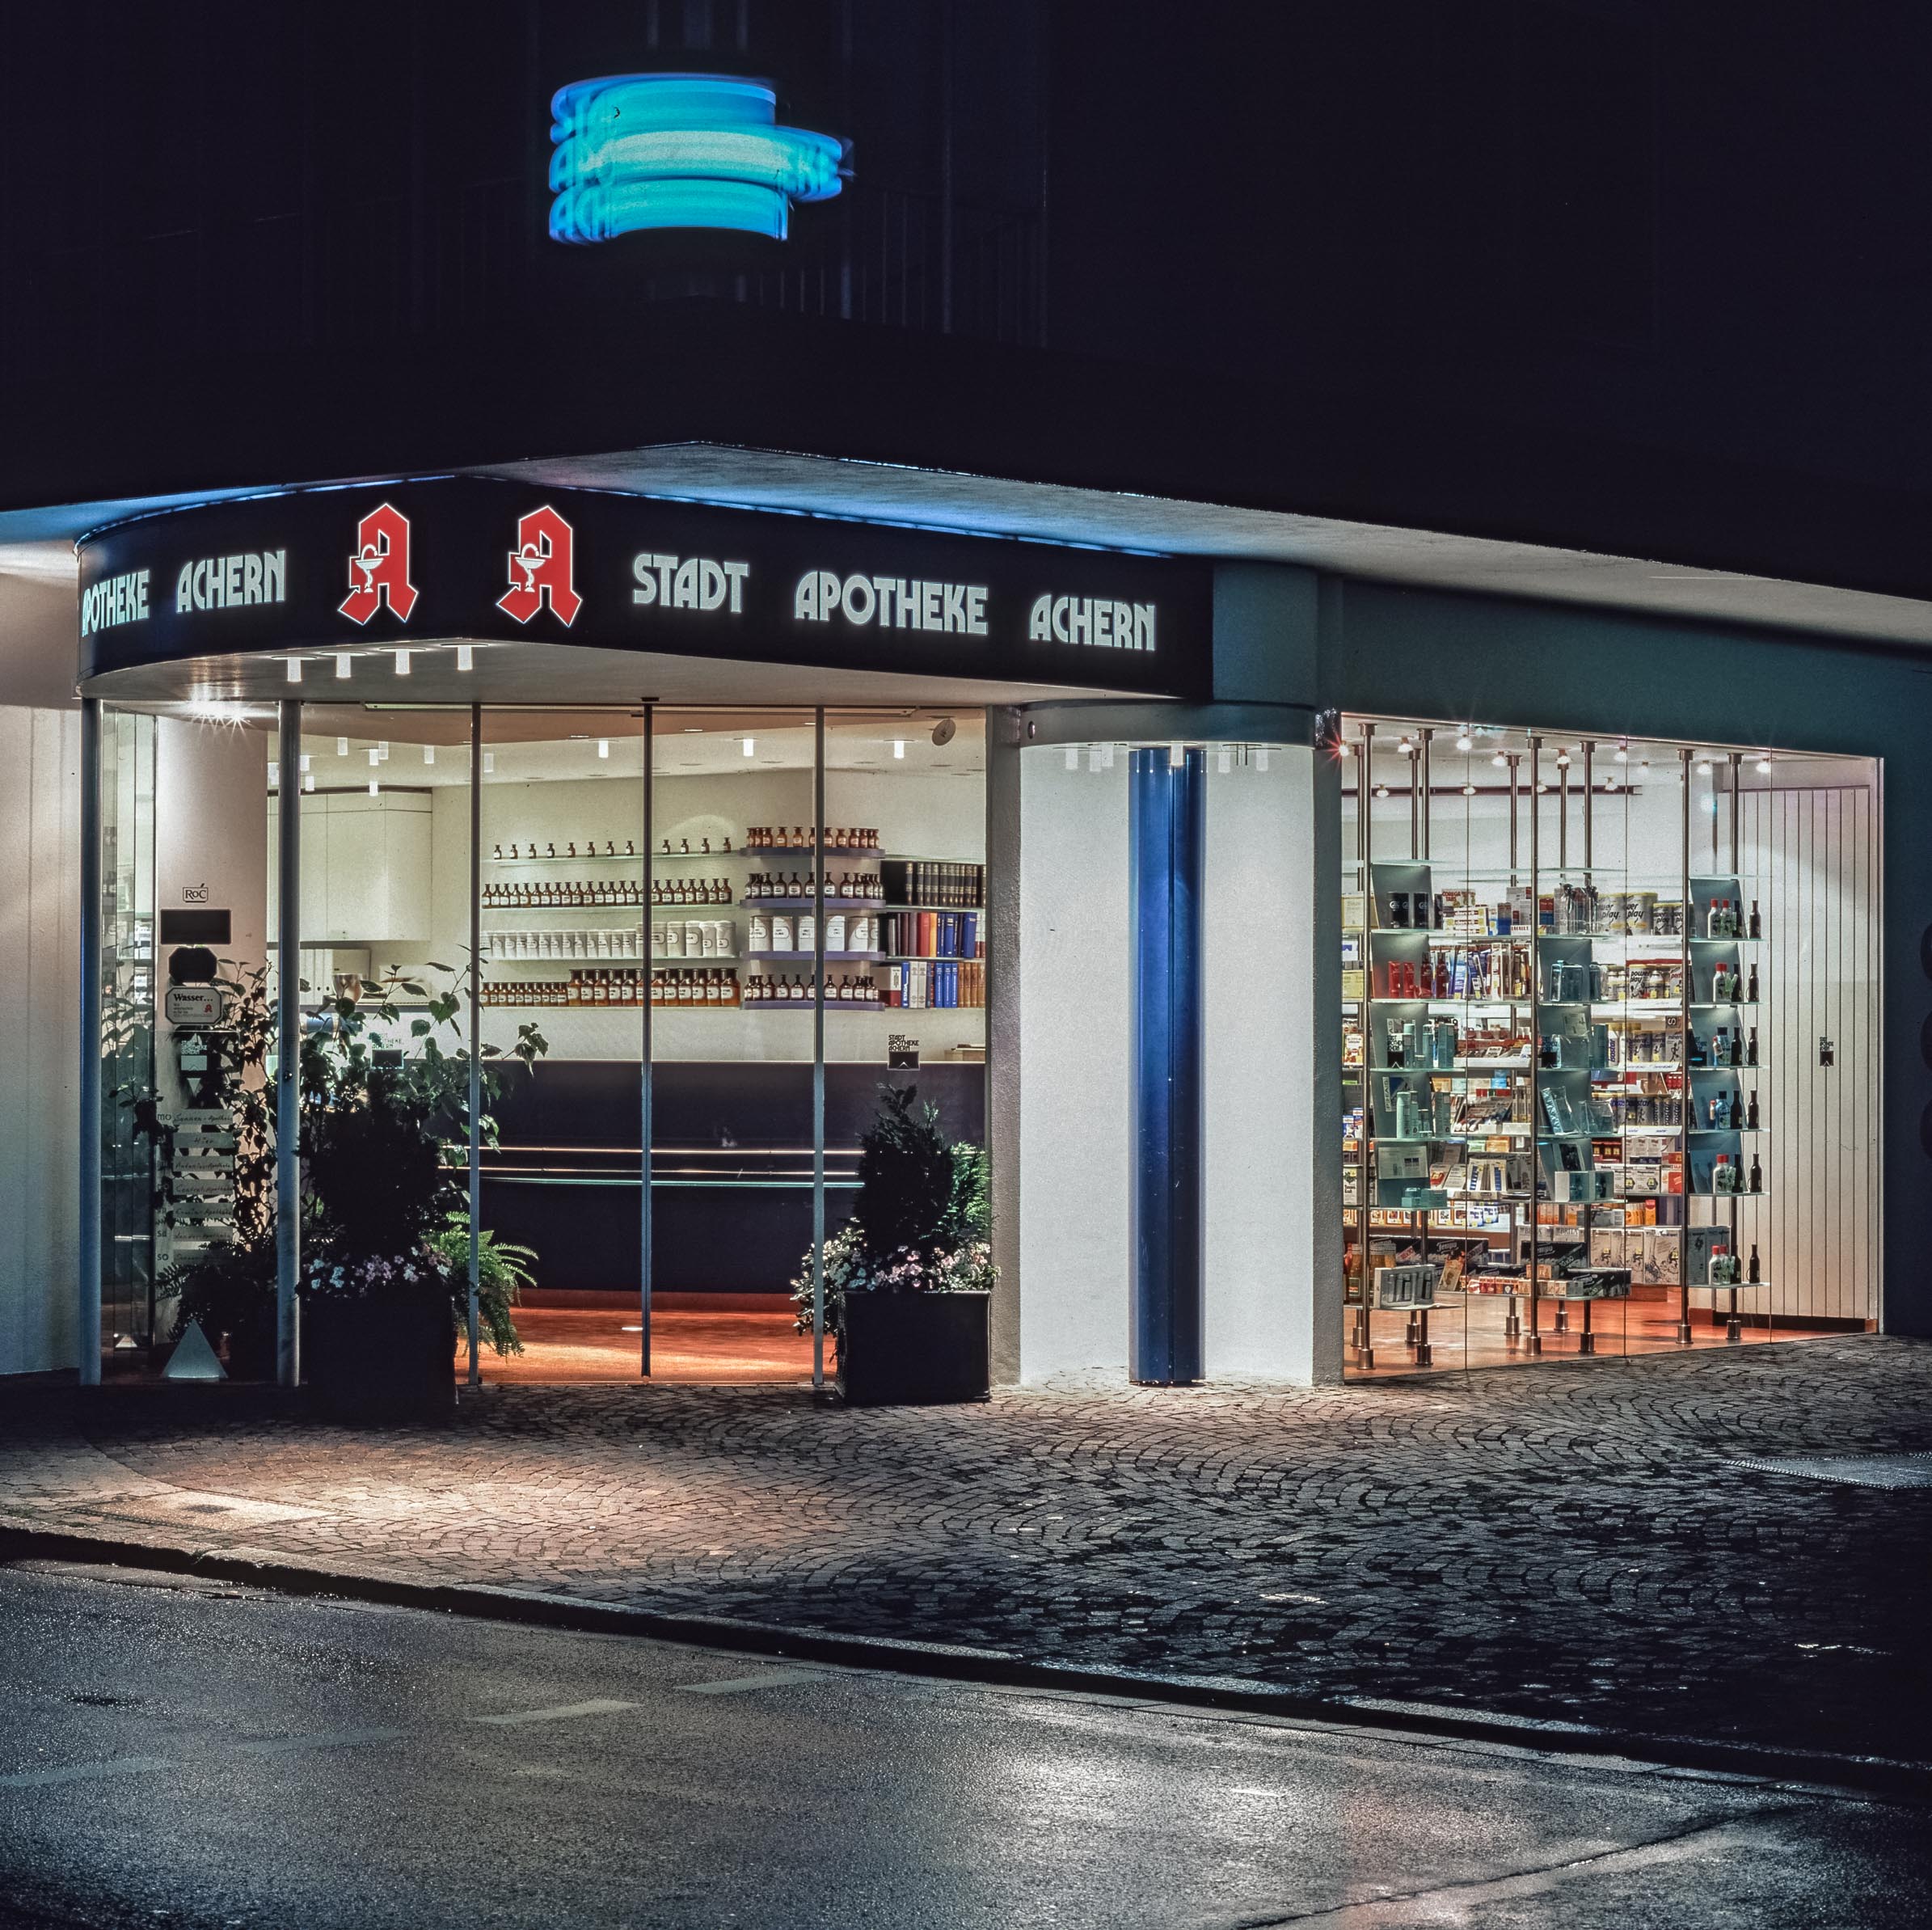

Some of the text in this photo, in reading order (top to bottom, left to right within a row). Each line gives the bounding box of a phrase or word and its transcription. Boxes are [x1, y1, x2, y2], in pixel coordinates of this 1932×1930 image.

[175, 550, 286, 613] ACHERN
[633, 553, 1156, 650] STADT APOTHEKE ACHERN
